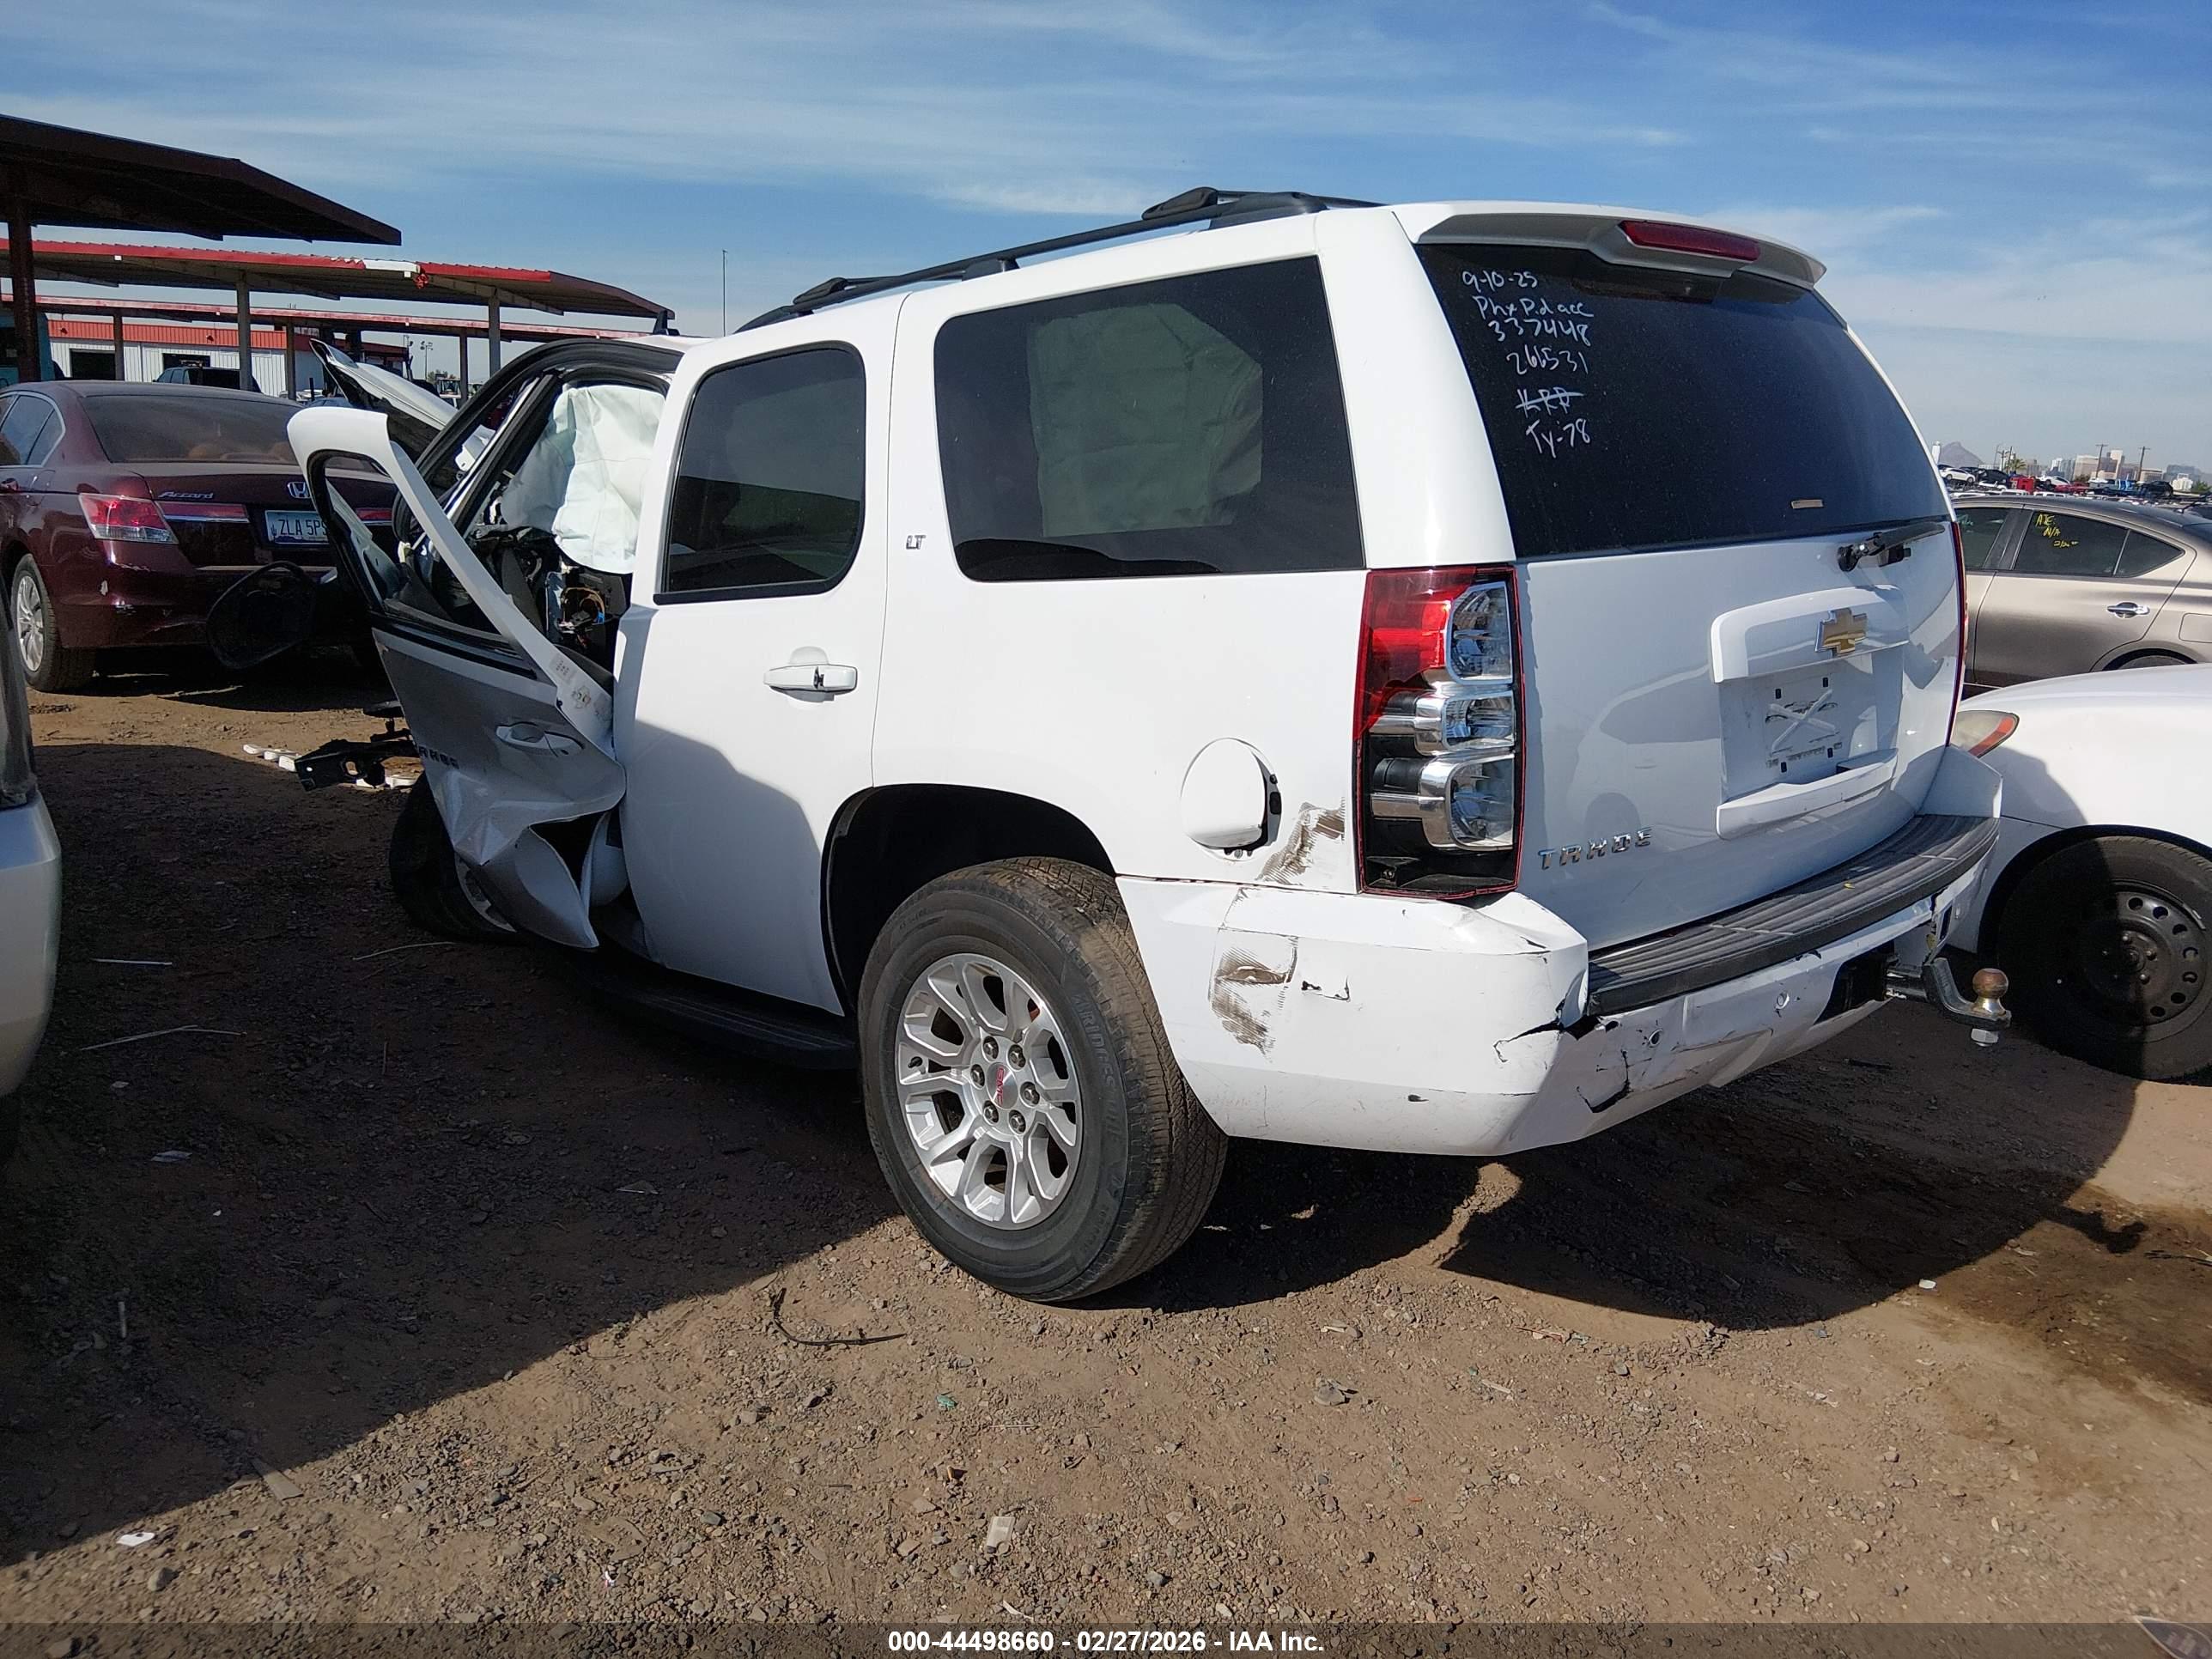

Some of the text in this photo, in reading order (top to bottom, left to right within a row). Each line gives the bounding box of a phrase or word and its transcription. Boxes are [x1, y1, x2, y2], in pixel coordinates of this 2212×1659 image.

[1462, 270, 1538, 293] 9-10-25
[1488, 317, 1591, 346] 337448
[1506, 345, 1589, 374] 266531
[277, 519, 303, 535] ZLA
[906, 535, 927, 550] LT
[1538, 827, 1652, 870] TAHOE
